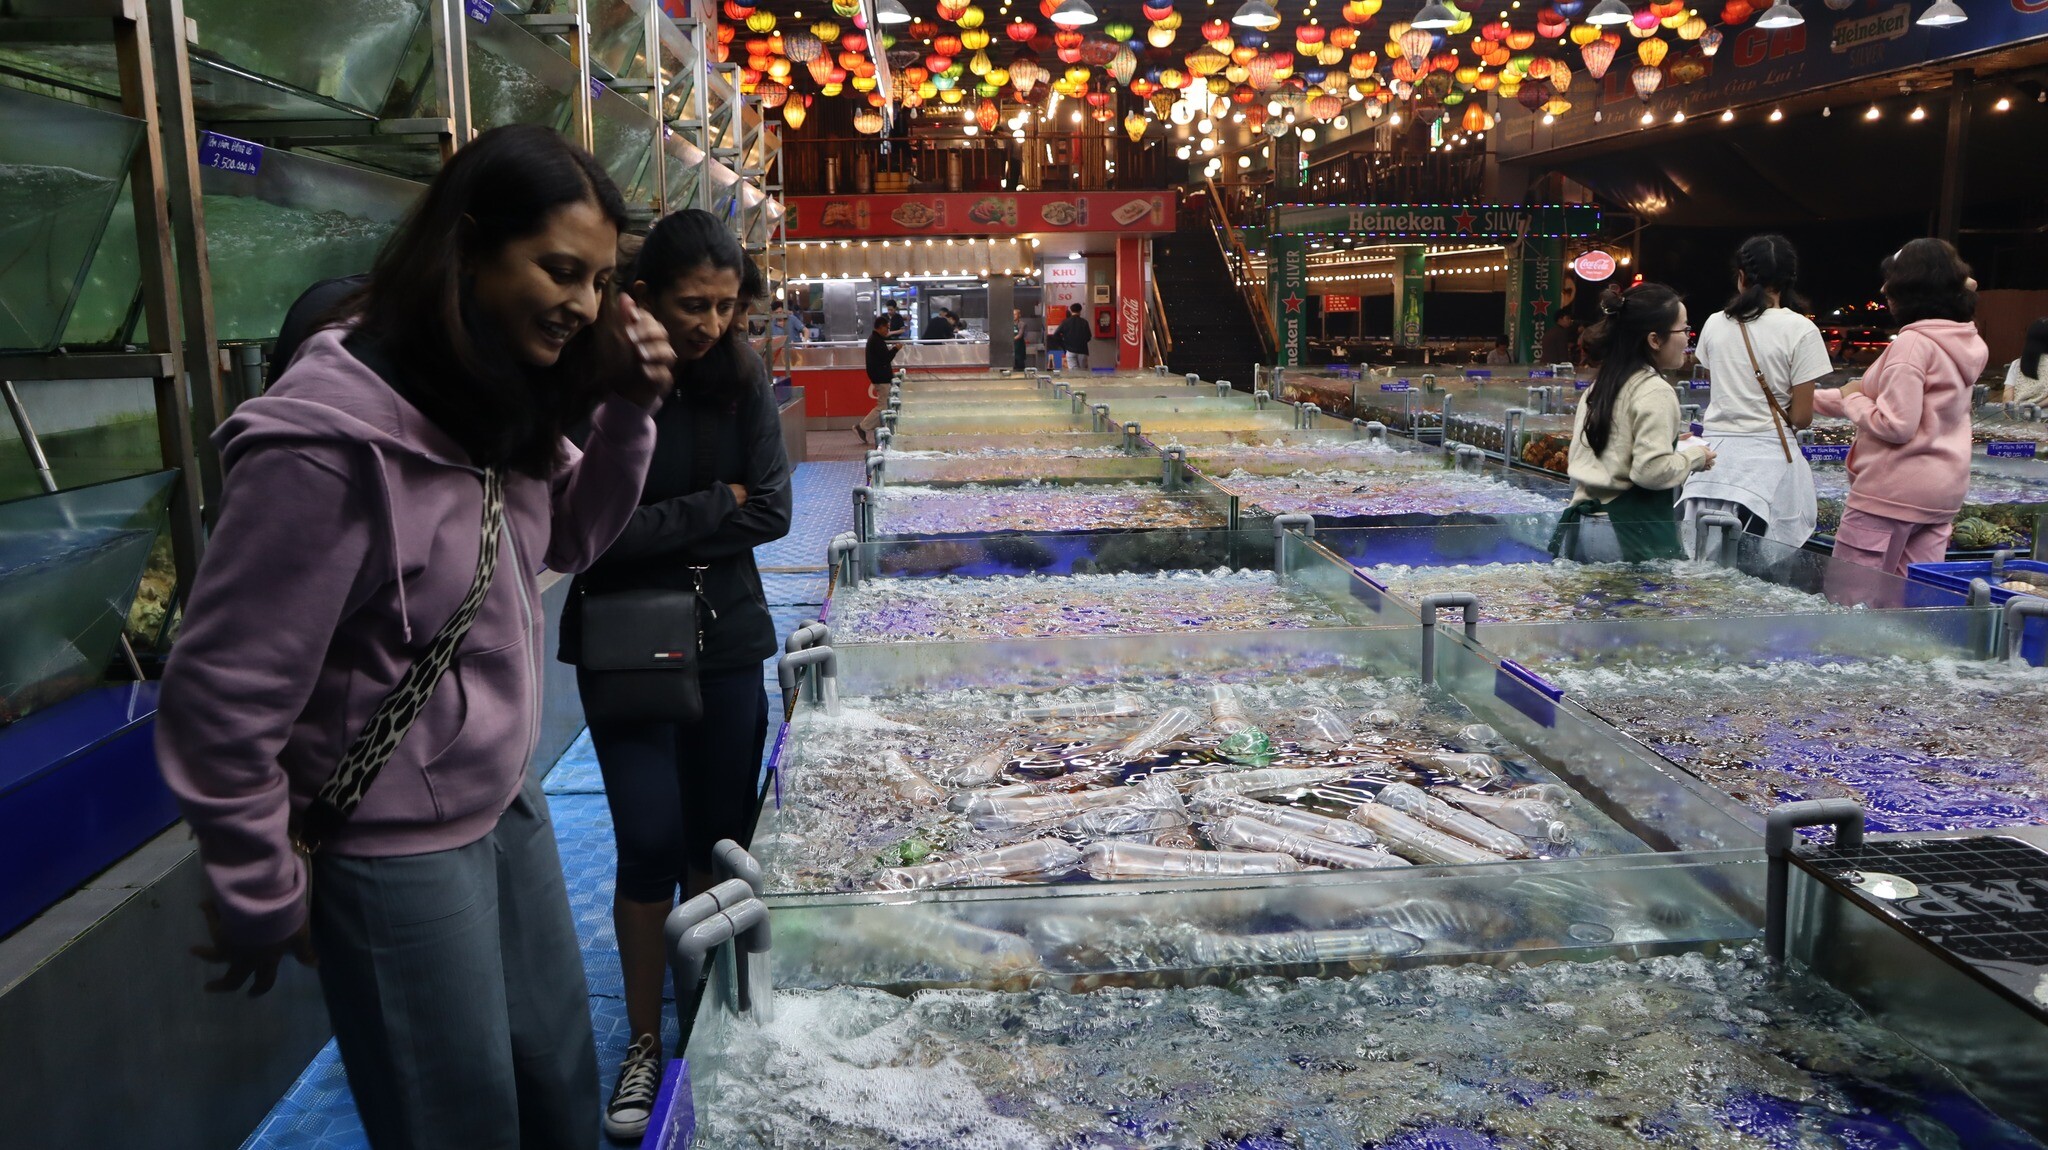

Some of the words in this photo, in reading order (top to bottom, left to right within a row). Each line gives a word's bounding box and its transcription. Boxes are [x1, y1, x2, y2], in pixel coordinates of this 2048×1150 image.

[1836, 13, 1905, 46] Heineken
[1849, 44, 1886, 69] SILVER
[1348, 210, 1446, 231] Heineken
[1052, 268, 1077, 276] KHU
[1285, 249, 1300, 288] SILVER
[1122, 296, 1140, 346] Coca-Cola
